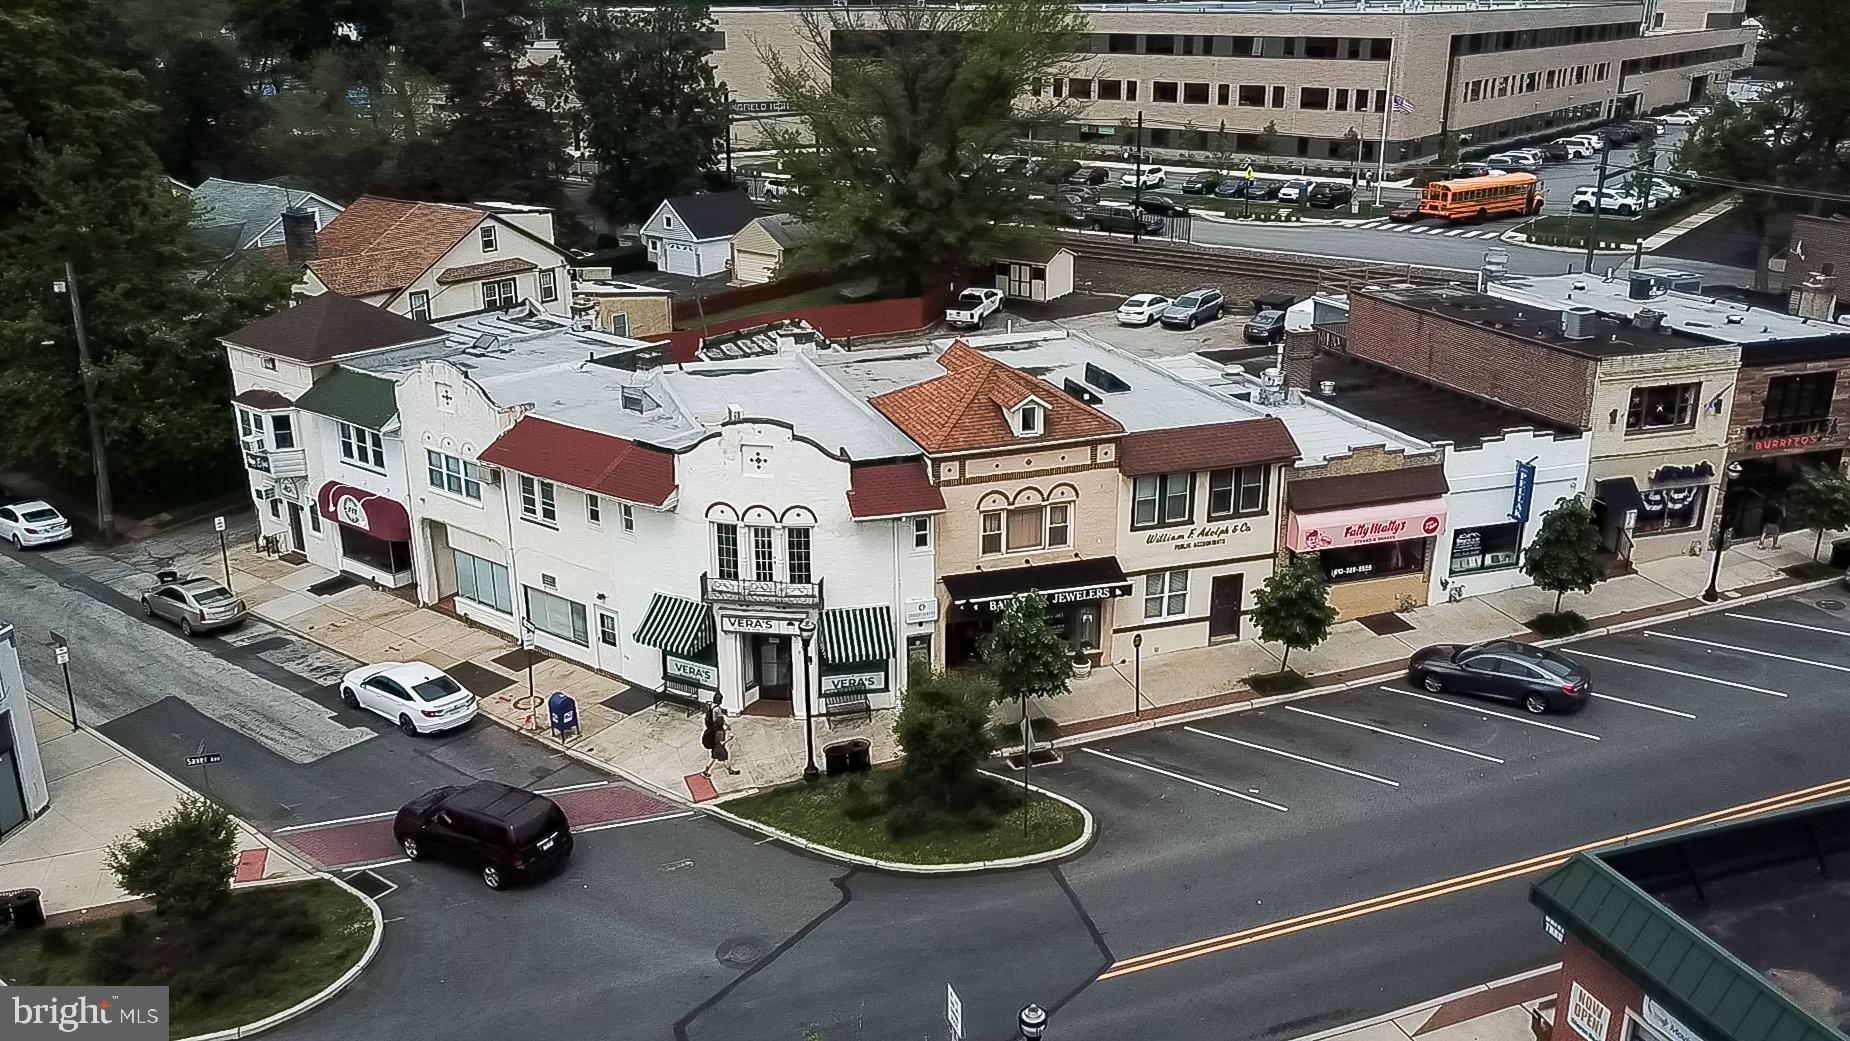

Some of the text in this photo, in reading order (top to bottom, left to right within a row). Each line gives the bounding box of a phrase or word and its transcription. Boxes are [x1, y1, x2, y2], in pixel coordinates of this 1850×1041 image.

[1755, 435, 1821, 450] BURRITOS
[1146, 533, 1184, 545] William
[1197, 526, 1229, 538] Adolph
[1232, 524, 1239, 534] &
[1344, 520, 1406, 538] Fatty Matty's
[1053, 588, 1110, 603] JEWELERS
[729, 618, 772, 629] VERA'S
[675, 662, 711, 679] VERA'S
[831, 676, 875, 689] VERA'S
[1578, 989, 1604, 1020] NOW
[1574, 1002, 1603, 1037] OPEN!
